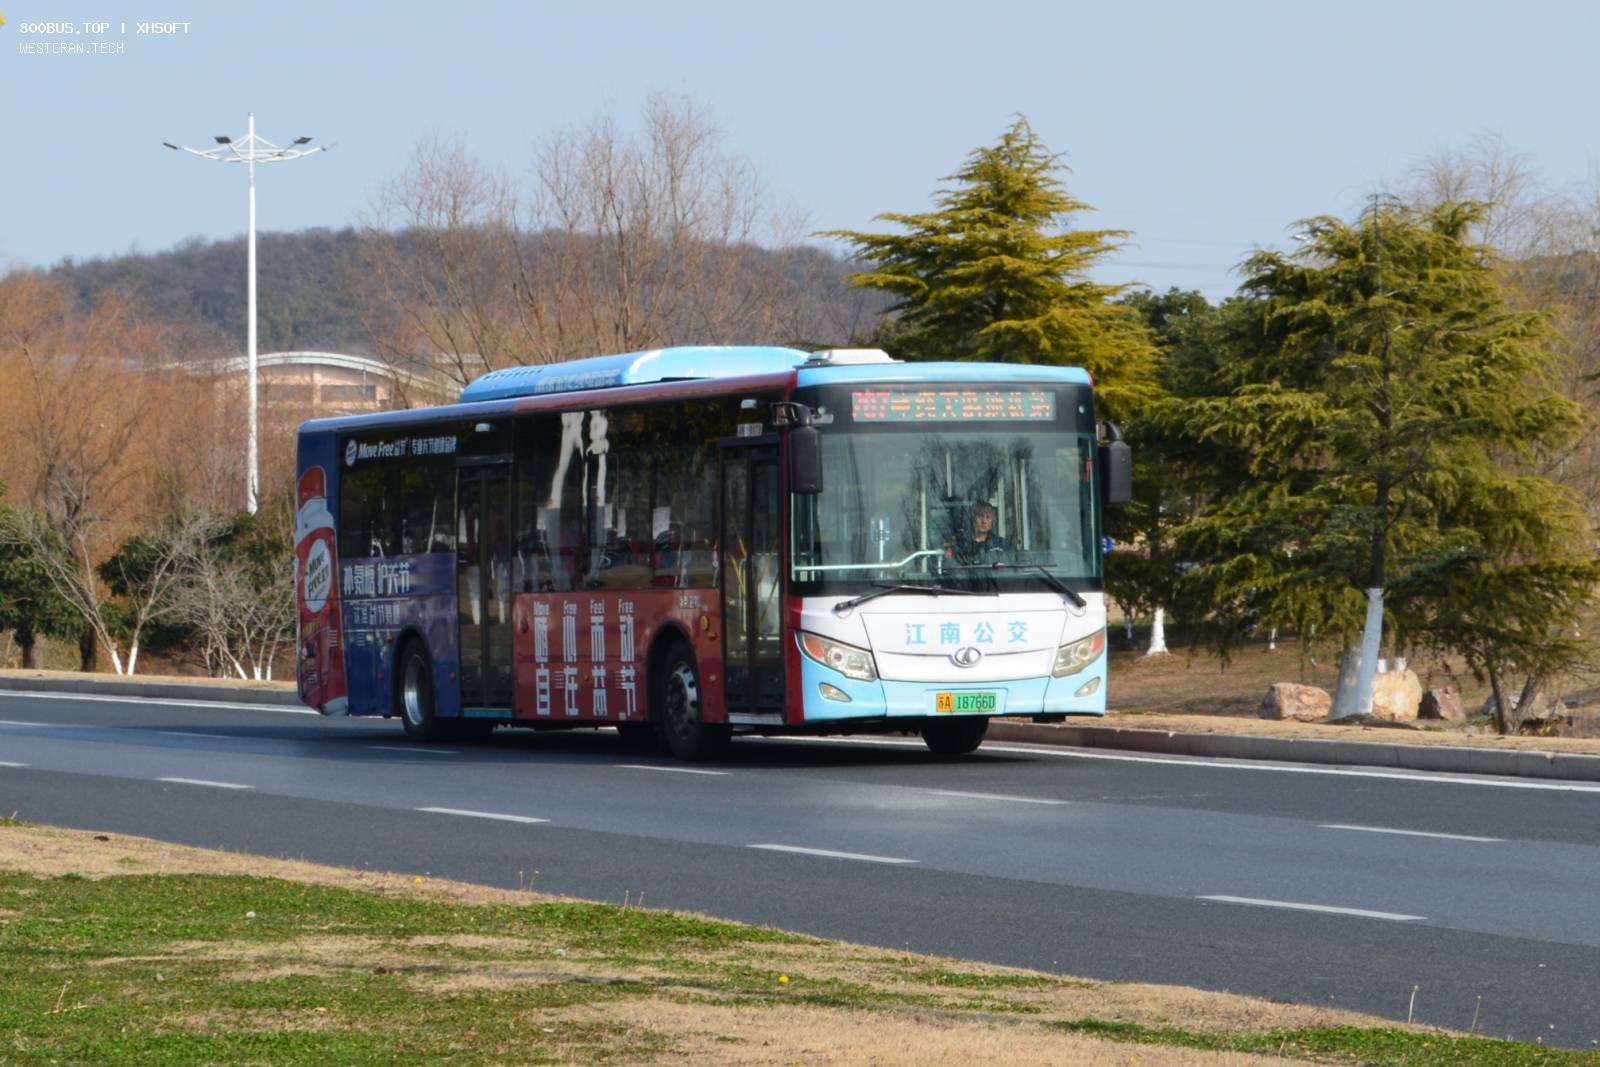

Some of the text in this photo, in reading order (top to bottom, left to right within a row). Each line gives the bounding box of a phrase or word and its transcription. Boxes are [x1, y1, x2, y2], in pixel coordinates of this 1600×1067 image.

[358, 442, 377, 459] Move
[378, 441, 393, 457] Free
[905, 620, 1028, 645] 江南公交
